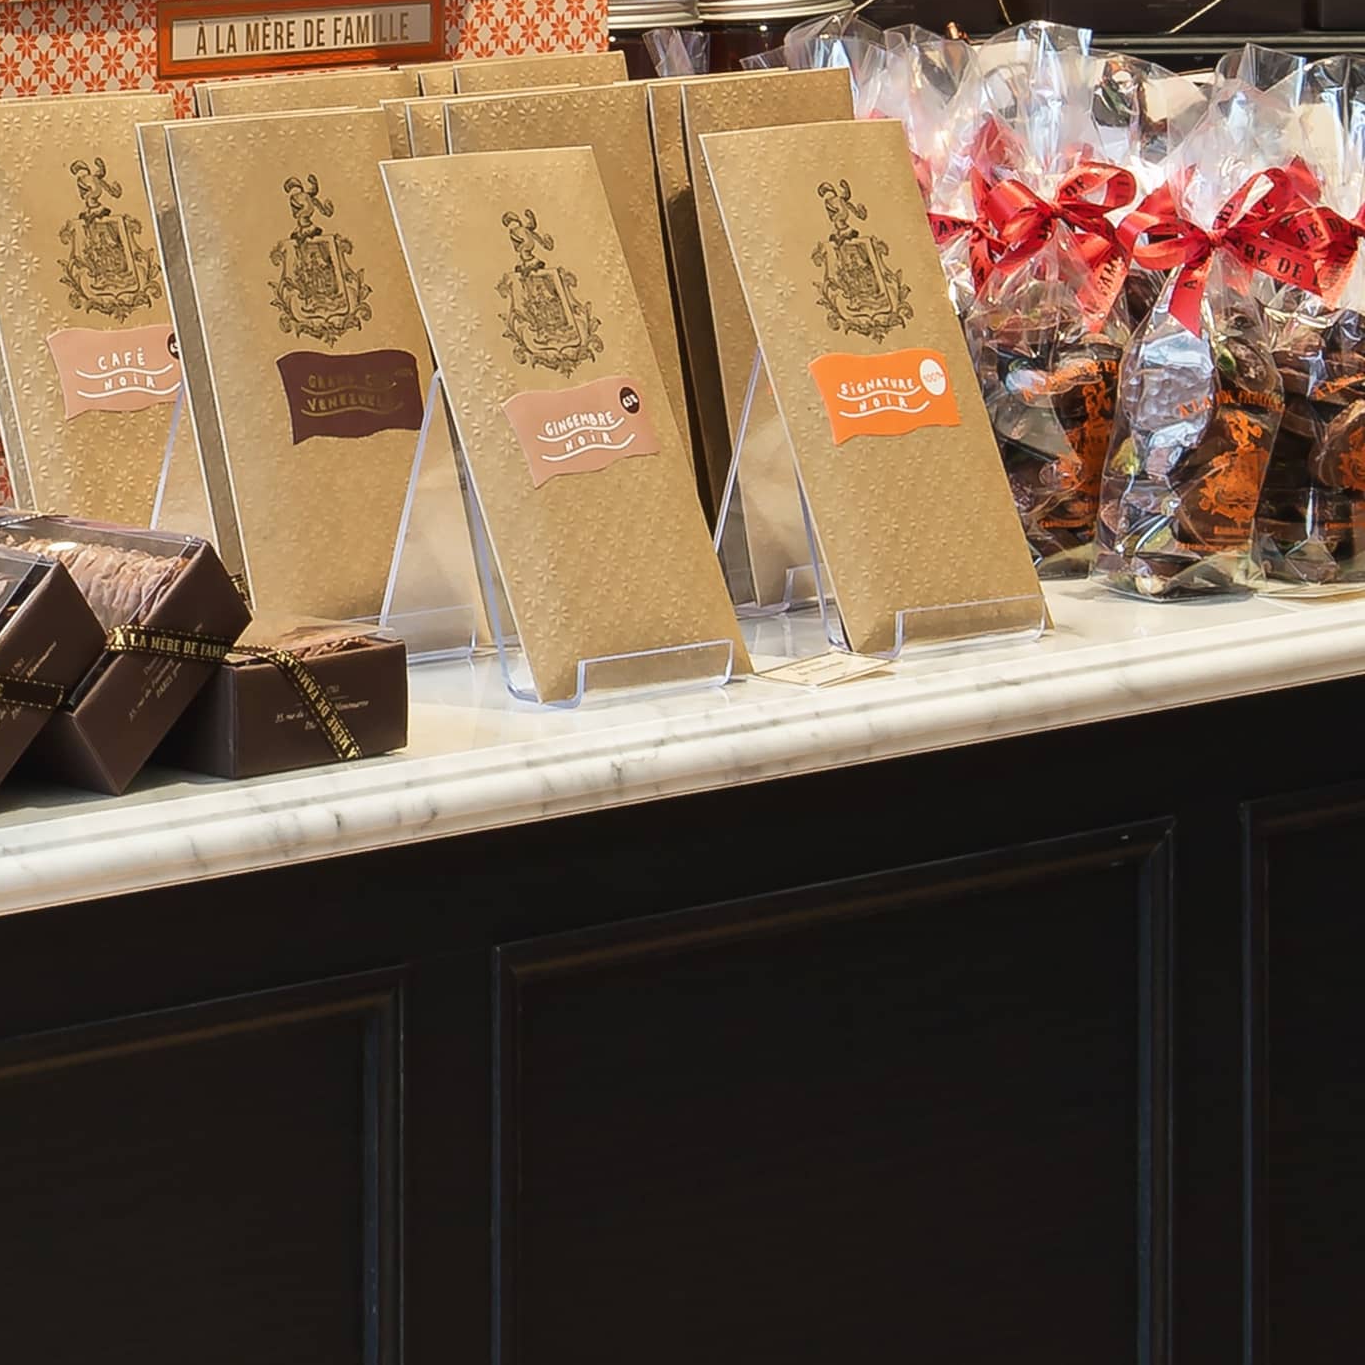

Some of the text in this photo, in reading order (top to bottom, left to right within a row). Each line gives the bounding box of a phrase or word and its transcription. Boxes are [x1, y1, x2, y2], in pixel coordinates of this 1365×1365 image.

[196, 11, 411, 56] À LA MÈRE DE FAMILLE
[1277, 256, 1304, 281] DE
[97, 346, 147, 369] CAFÉ
[544, 410, 616, 437] GINGEMBRE
[130, 632, 148, 648] LA
[150, 633, 181, 654] MÈRE
[183, 640, 198, 655] DE
